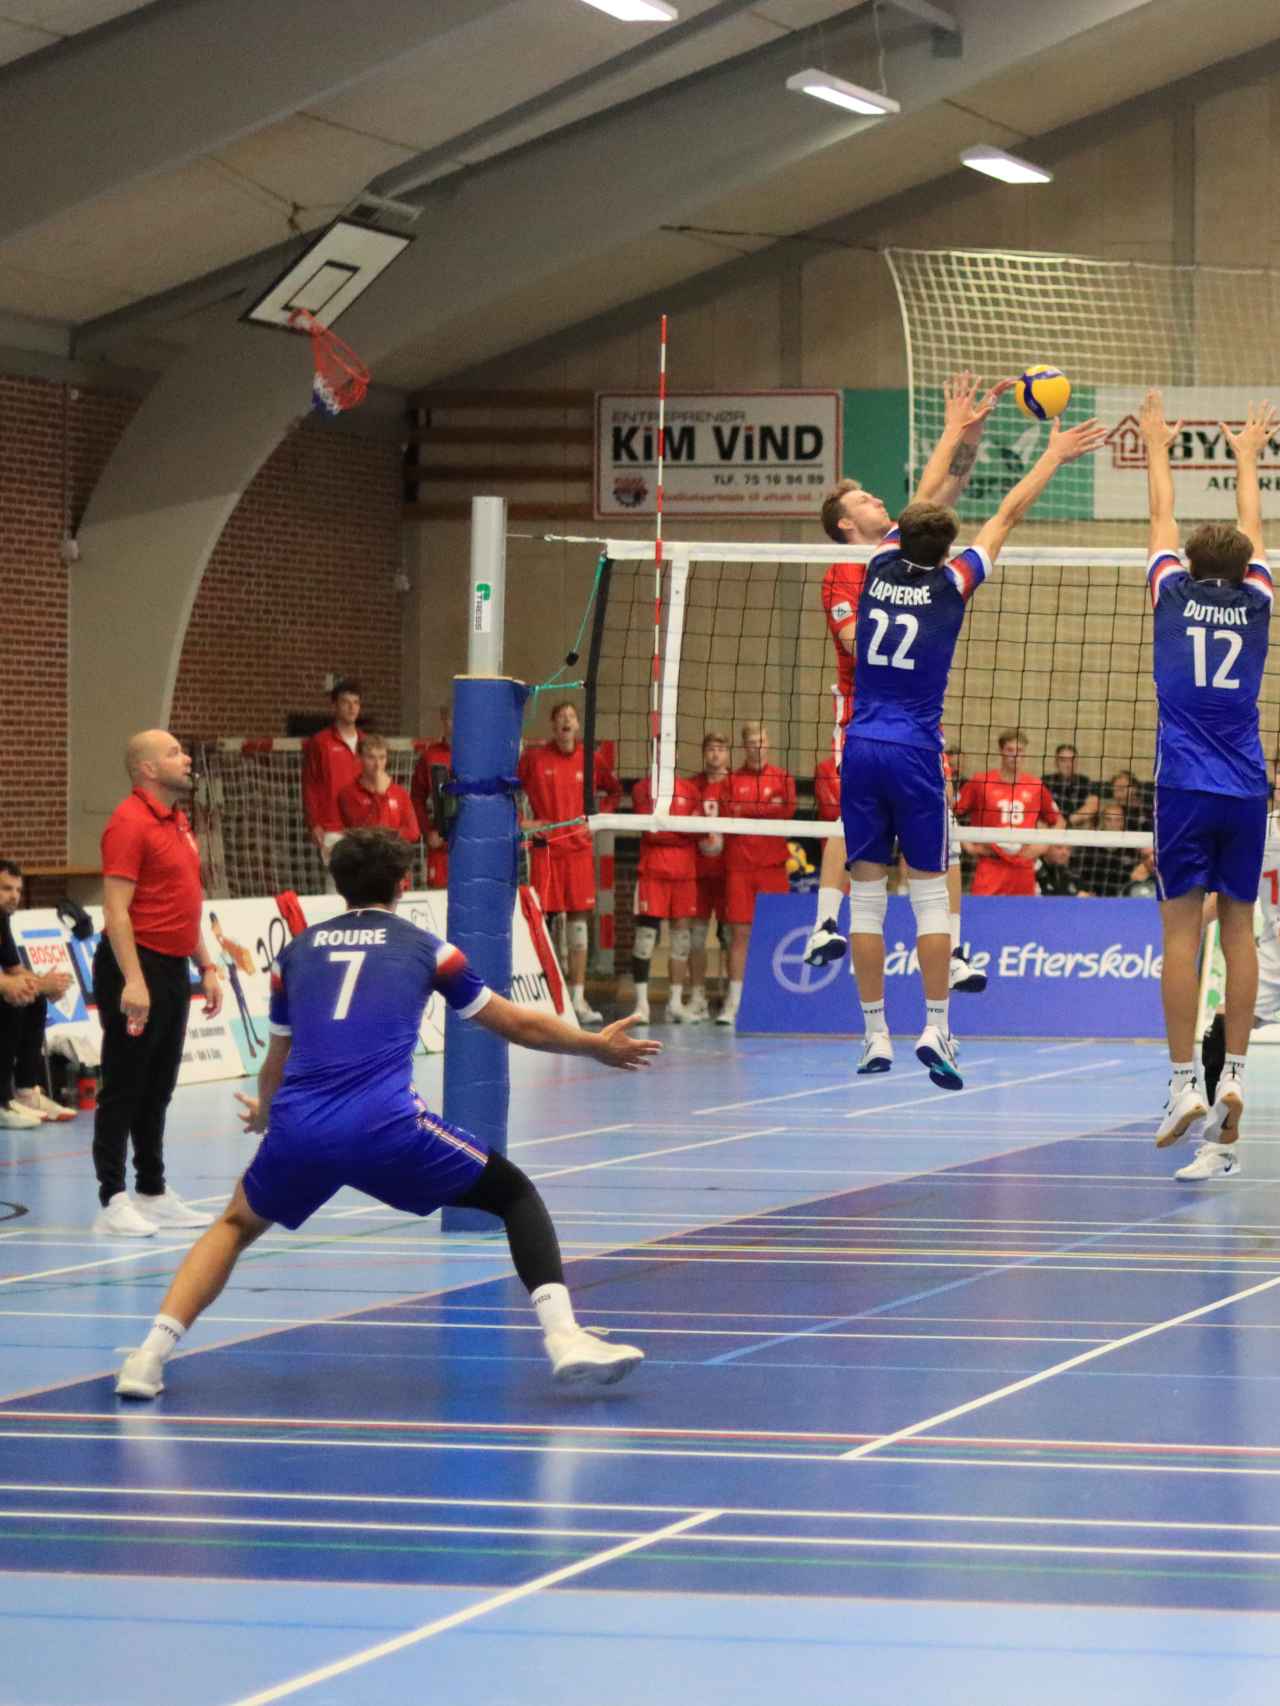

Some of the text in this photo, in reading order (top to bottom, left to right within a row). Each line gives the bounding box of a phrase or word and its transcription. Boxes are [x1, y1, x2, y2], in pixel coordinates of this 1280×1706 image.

[868, 577, 932, 606] LAPIERRE
[1183, 600, 1248, 625] DUTHOIT
[867, 608, 918, 670] 22
[1186, 626, 1243, 689] 12
[29, 943, 68, 965] BOSCH
[313, 929, 387, 947] ROURE
[998, 943, 1163, 979] Efterskole
[329, 951, 367, 1020] 7
